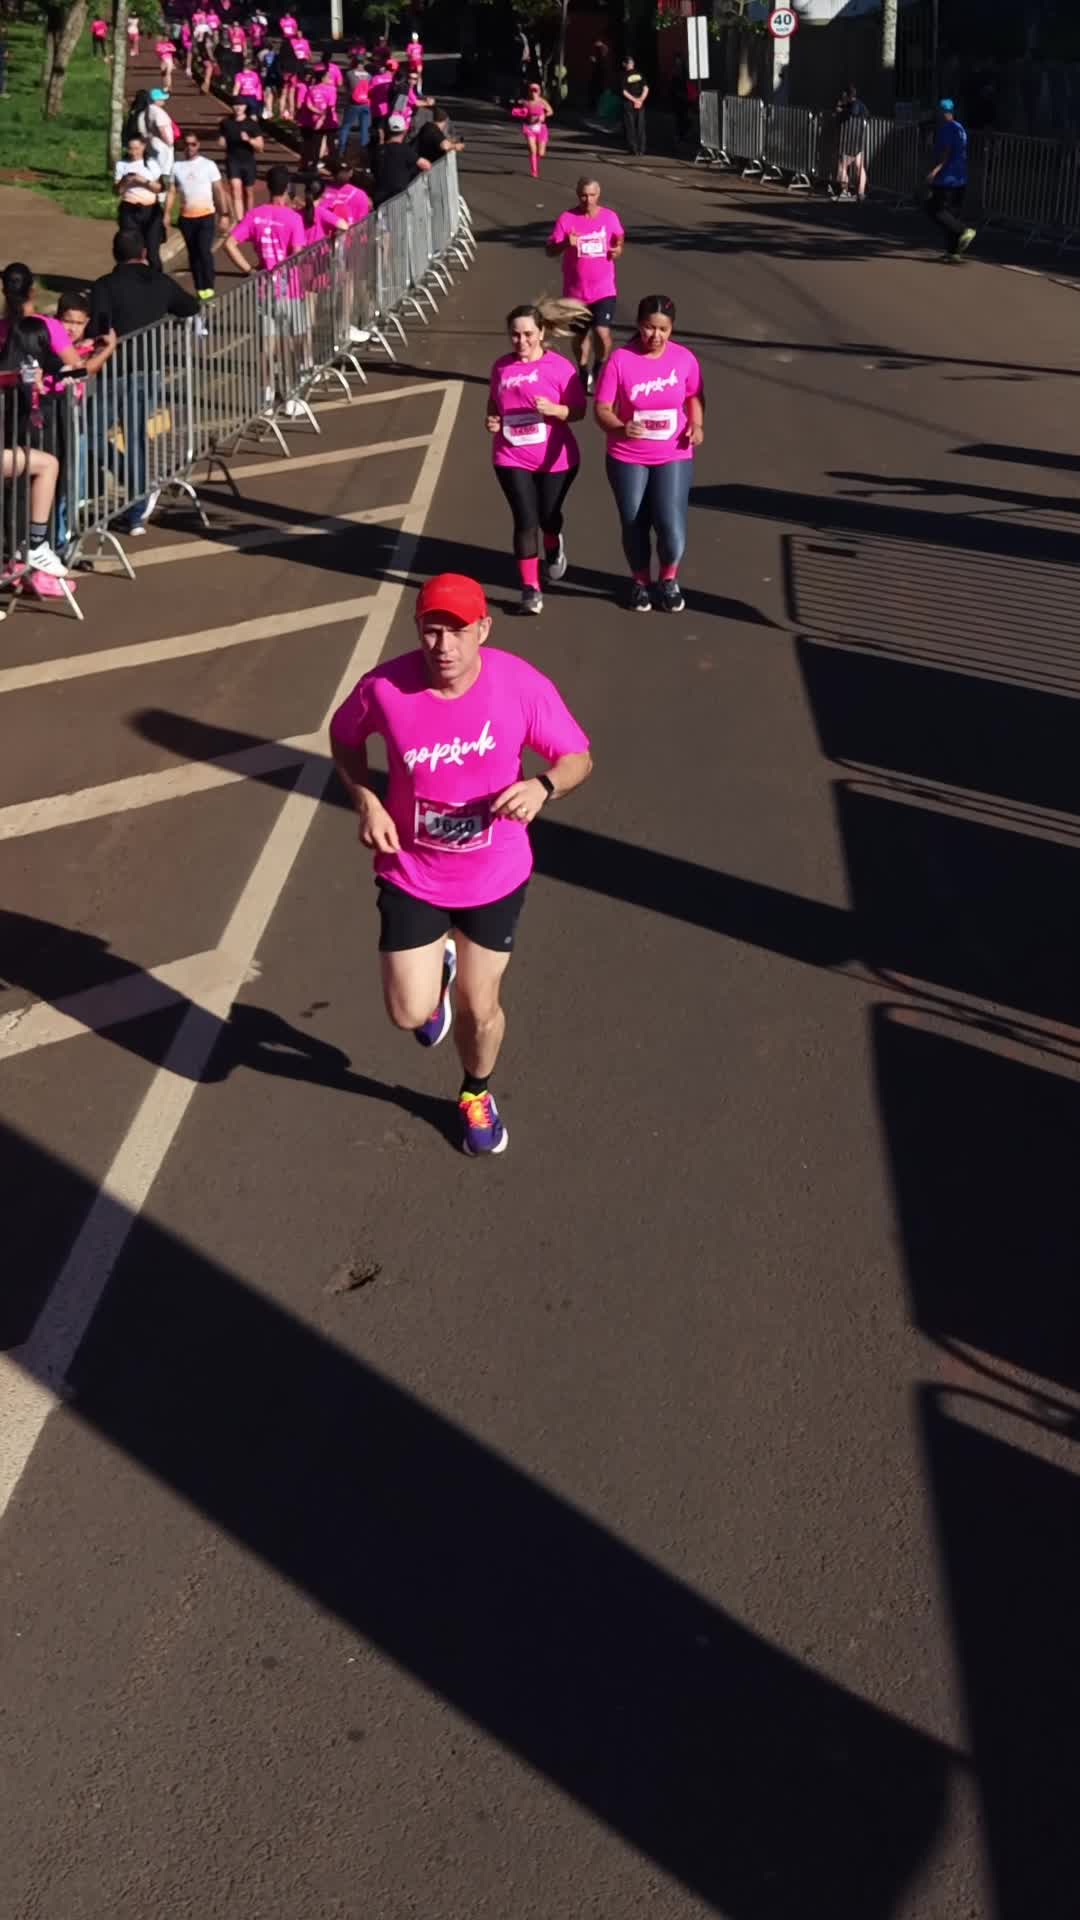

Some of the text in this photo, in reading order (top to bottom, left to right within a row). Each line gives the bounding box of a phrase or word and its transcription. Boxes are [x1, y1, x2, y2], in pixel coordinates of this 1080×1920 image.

[773, 14, 792, 25] 40
[630, 367, 679, 400] gopink
[403, 720, 496, 774] gopink
[434, 817, 475, 833] 1640
